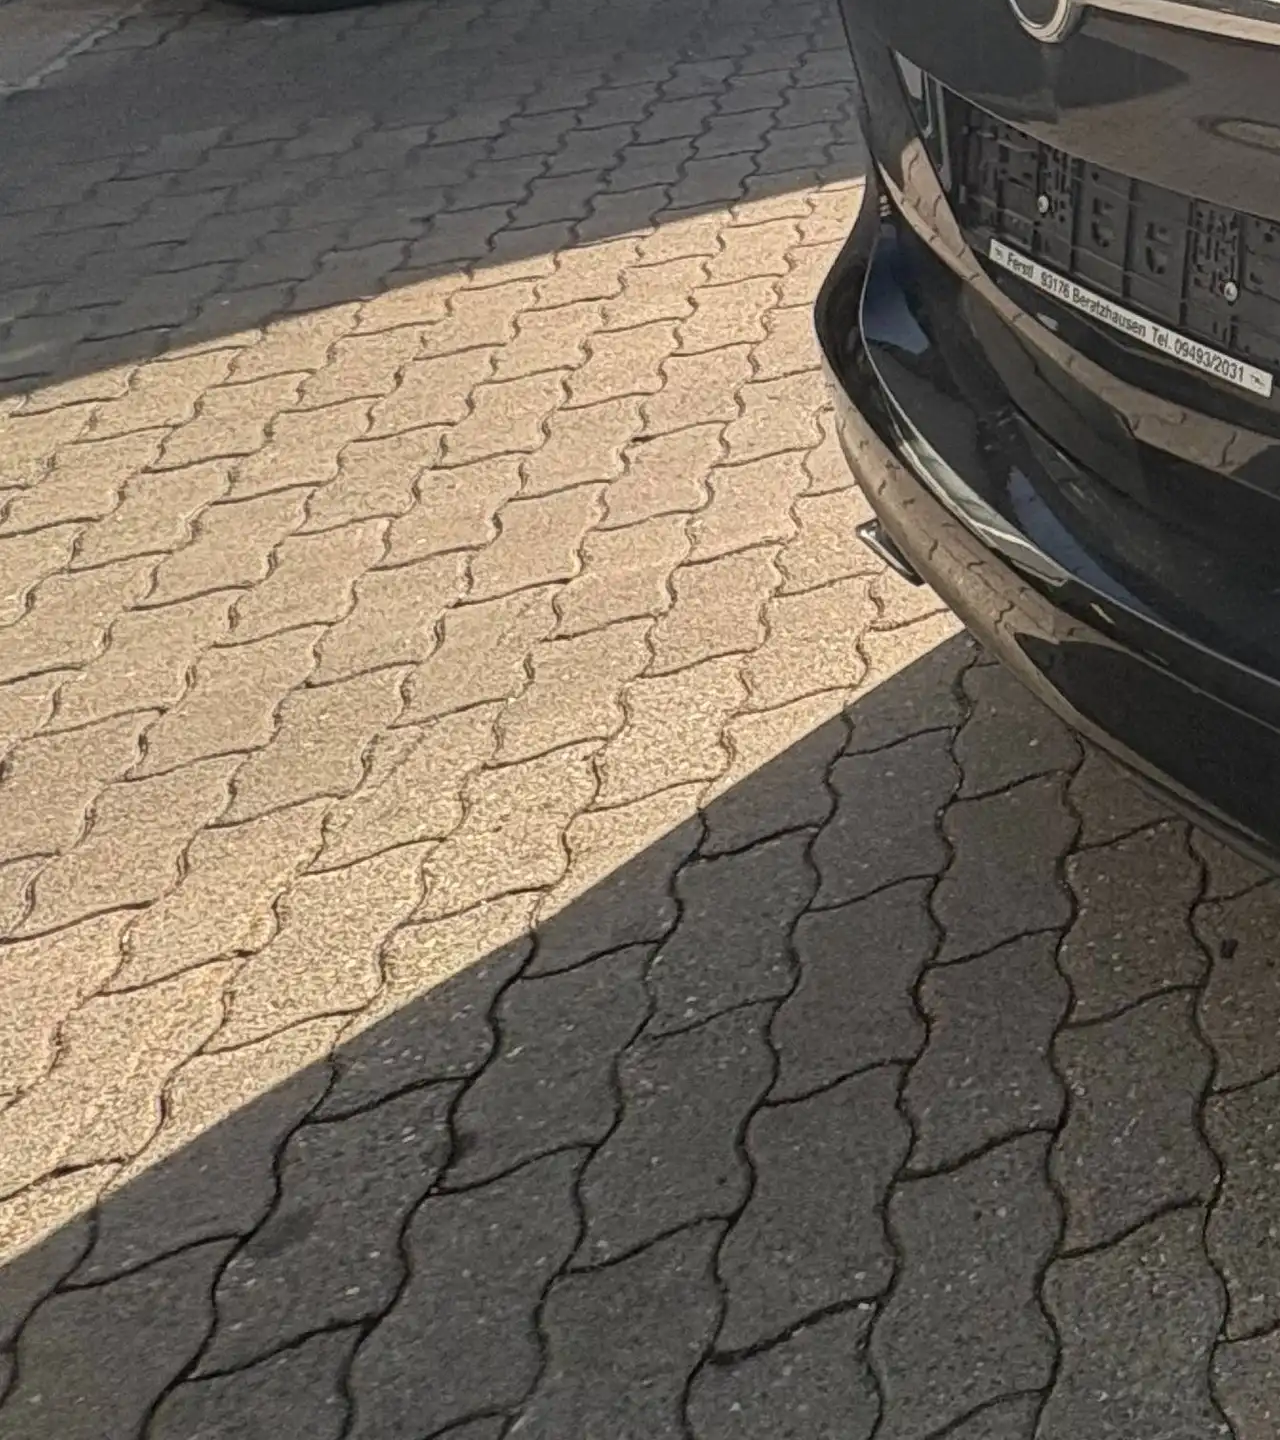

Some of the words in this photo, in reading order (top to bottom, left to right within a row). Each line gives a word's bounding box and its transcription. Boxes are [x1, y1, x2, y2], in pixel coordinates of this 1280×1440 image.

[1040, 271, 1070, 299] 93176
[1072, 287, 1147, 338] Beratzhausen
[1151, 326, 1173, 350] Tel.
[1174, 338, 1244, 382] 09493/2031
